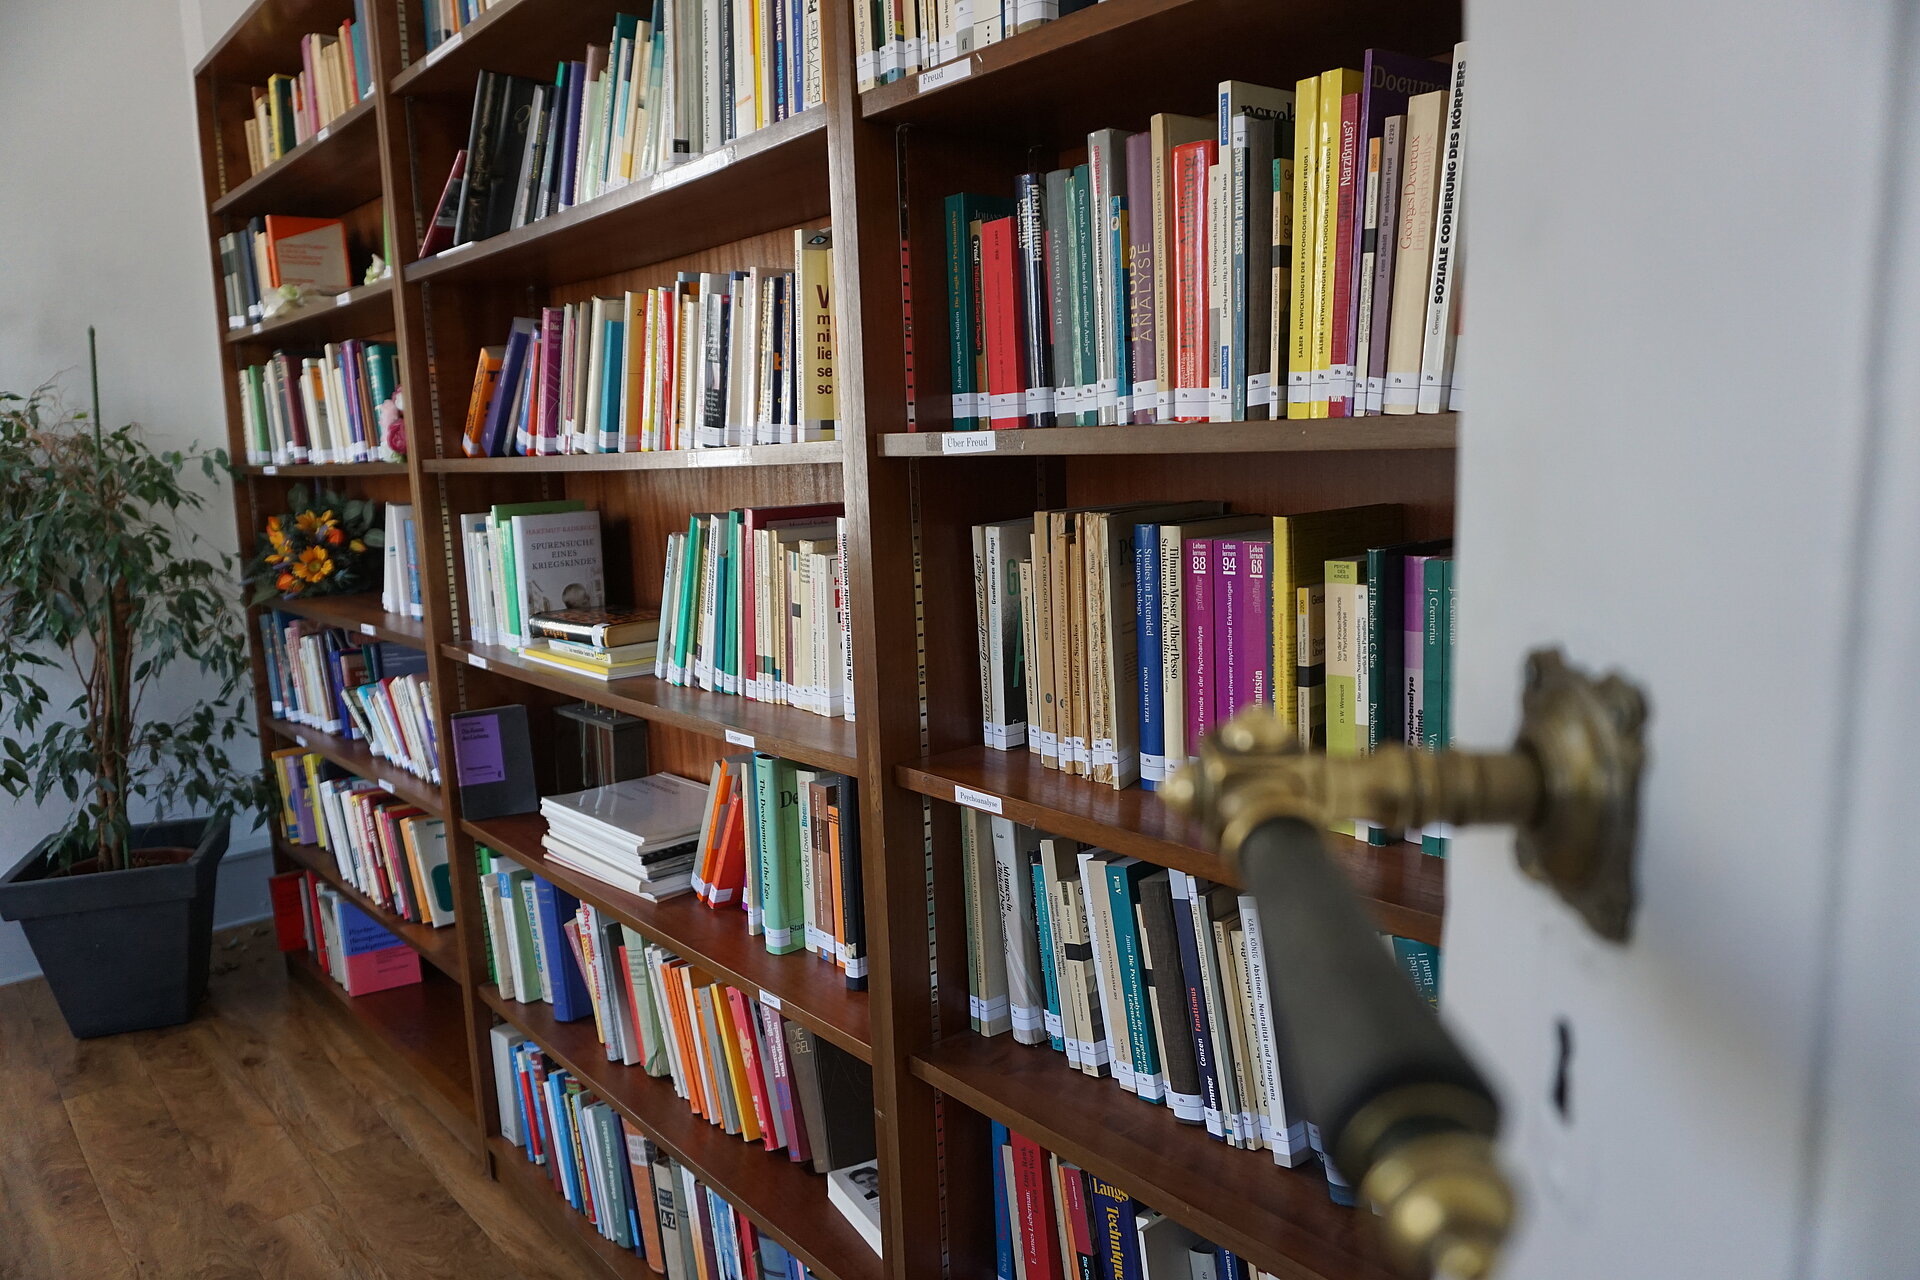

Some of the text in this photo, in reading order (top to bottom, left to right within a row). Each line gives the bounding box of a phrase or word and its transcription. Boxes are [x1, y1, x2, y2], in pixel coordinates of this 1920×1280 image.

[776, 41, 784, 105] Schmidbauer
[922, 68, 944, 85] Freud
[1340, 120, 1354, 187] Narzißmus?
[1029, 184, 1041, 216] Freud
[1400, 135, 1421, 250] Georges Devereux
[1412, 133, 1434, 251] Ethnopsychoanalyse
[1432, 60, 1467, 336] Clemenz SOZIALE CODIERUNG DES KÖRPERS
[1156, 190, 1164, 271] PSYCHOANALYTISCHEN
[1233, 219, 1244, 255] PROCESS
[1054, 228, 1064, 325] Die Psychoanalyse
[1129, 244, 1139, 342] FREUDS
[1138, 243, 1153, 342] ANALYSE
[1319, 270, 1327, 326] ENTWICKLUNGEN
[947, 436, 989, 448] Über Freud
[531, 538, 595, 551] SPURENSUCHE
[532, 558, 597, 570] KRIEGSKINDES
[551, 549, 577, 559] EINES
[989, 537, 997, 554] Angst
[1161, 537, 1170, 589] Strukturen
[1192, 542, 1207, 550] Leben
[1192, 549, 1207, 557] lernen
[1192, 556, 1207, 571] 88
[1222, 556, 1237, 571] 94
[1135, 548, 1143, 616] Metapsychology
[1251, 559, 1263, 574] 68
[1144, 548, 1154, 636] Studies in Extended
[1369, 588, 1377, 598] H.
[1169, 546, 1181, 680] Tilmann Albert Pesso
[1368, 599, 1377, 630] Brocher
[1427, 588, 1439, 645] J. Cremerius
[1162, 606, 1171, 665] Unbewußten
[1226, 627, 1234, 665] psychischer
[1370, 654, 1378, 668] Sies
[981, 665, 991, 703] RIEMANN
[1407, 676, 1416, 746] Psychoanalyse
[960, 791, 998, 808] Psychoanalyse
[760, 798, 768, 854] Development
[763, 855, 769, 865] of
[803, 854, 811, 889] Alexander
[1002, 862, 1011, 902] Advances
[1124, 934, 1132, 954] Janus
[1129, 967, 1141, 1019] Psychoanalyse
[1419, 958, 1434, 986] Band
[1127, 993, 1136, 1034] Lebenszeit
[1190, 987, 1201, 1032] Fanatismus
[1247, 918, 1277, 1101] KARL KÖNIG Abstinenz, Neutralität und Transparenz
[769, 1044, 781, 1078] Limerenz
[772, 1022, 784, 1063] Verliebtsein
[1199, 1038, 1207, 1067] Conzen
[1025, 1189, 1035, 1232] Lieberman:
[1029, 1233, 1037, 1257] James
